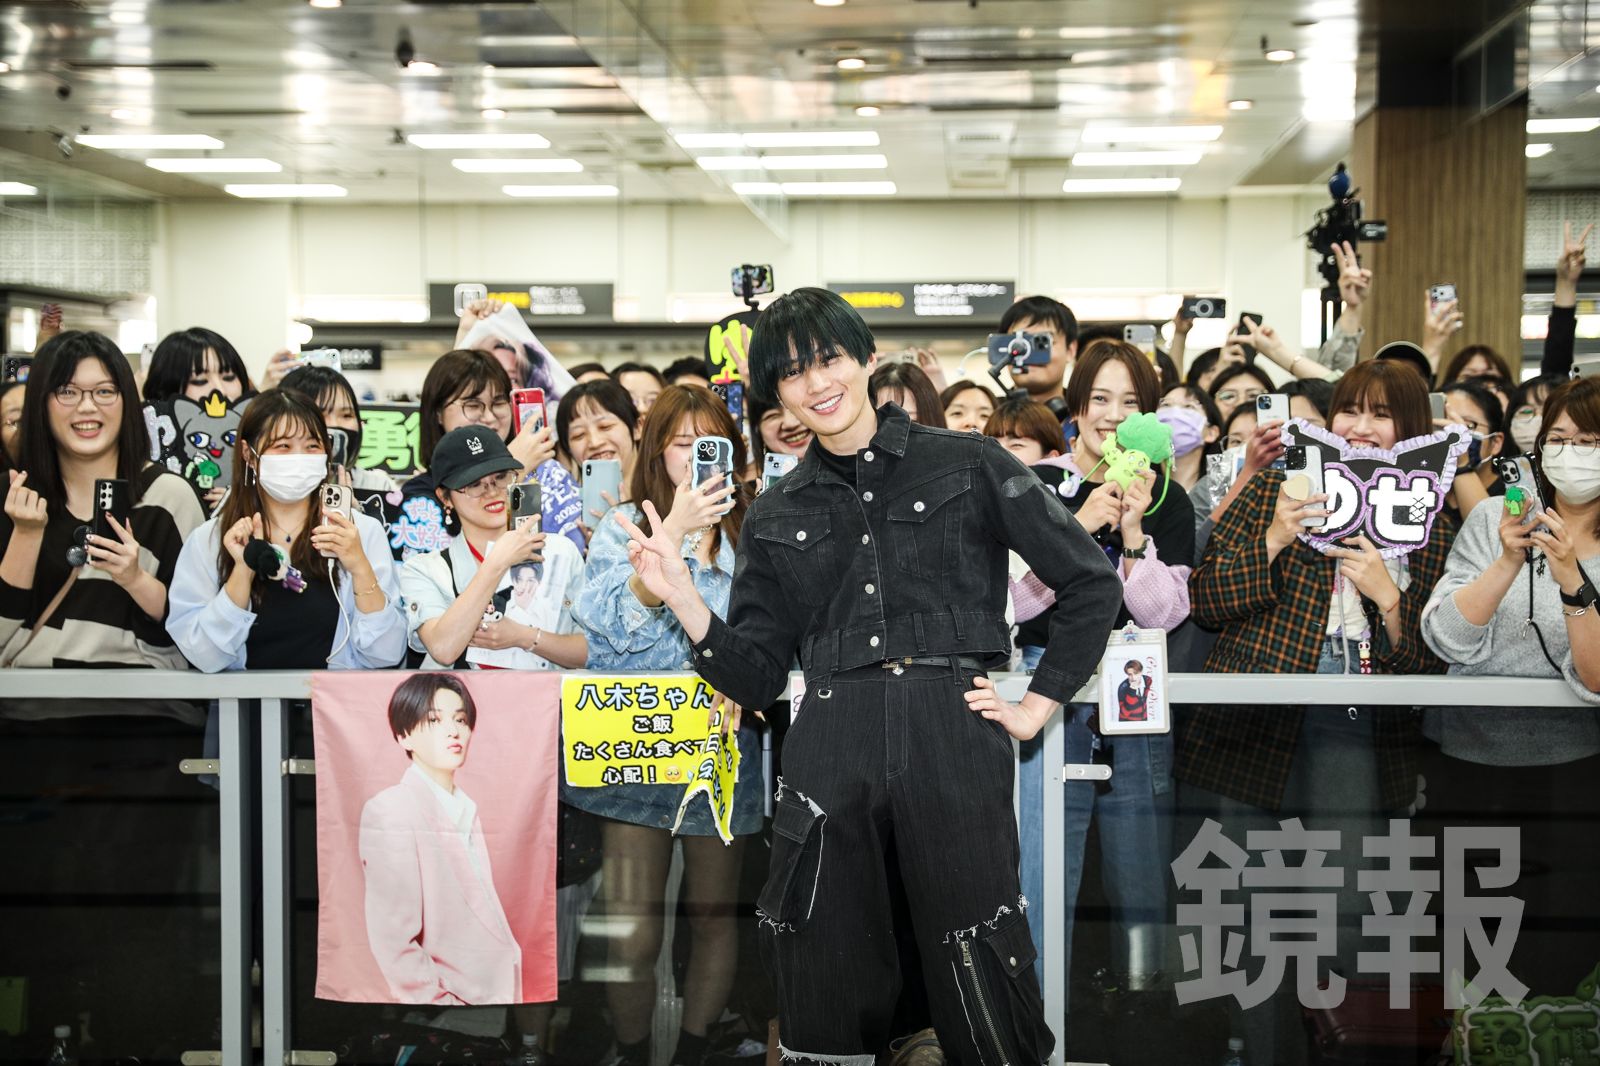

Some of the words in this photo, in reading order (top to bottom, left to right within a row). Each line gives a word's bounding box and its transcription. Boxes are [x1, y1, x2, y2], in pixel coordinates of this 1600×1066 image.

[404, 497, 443, 522] ずっと
[576, 682, 714, 711] 八木ちゃん
[632, 714, 673, 733] ご飯
